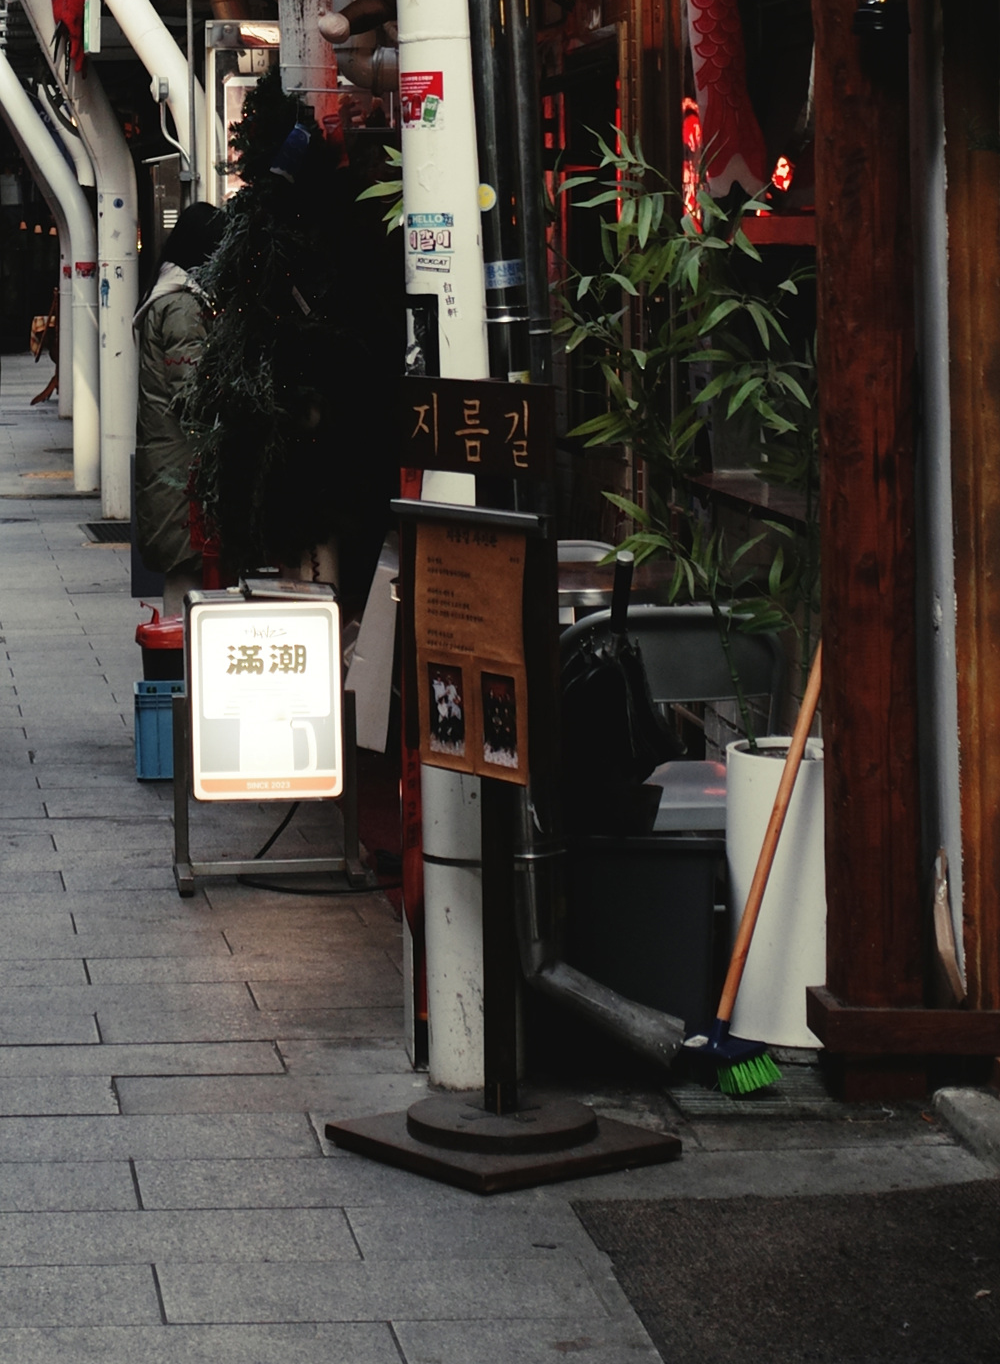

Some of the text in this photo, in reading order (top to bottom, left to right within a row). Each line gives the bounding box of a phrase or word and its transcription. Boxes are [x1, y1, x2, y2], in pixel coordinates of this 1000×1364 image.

[412, 214, 443, 224] HELLO
[411, 392, 530, 468] 지름길
[226, 643, 307, 675] 滿潮
